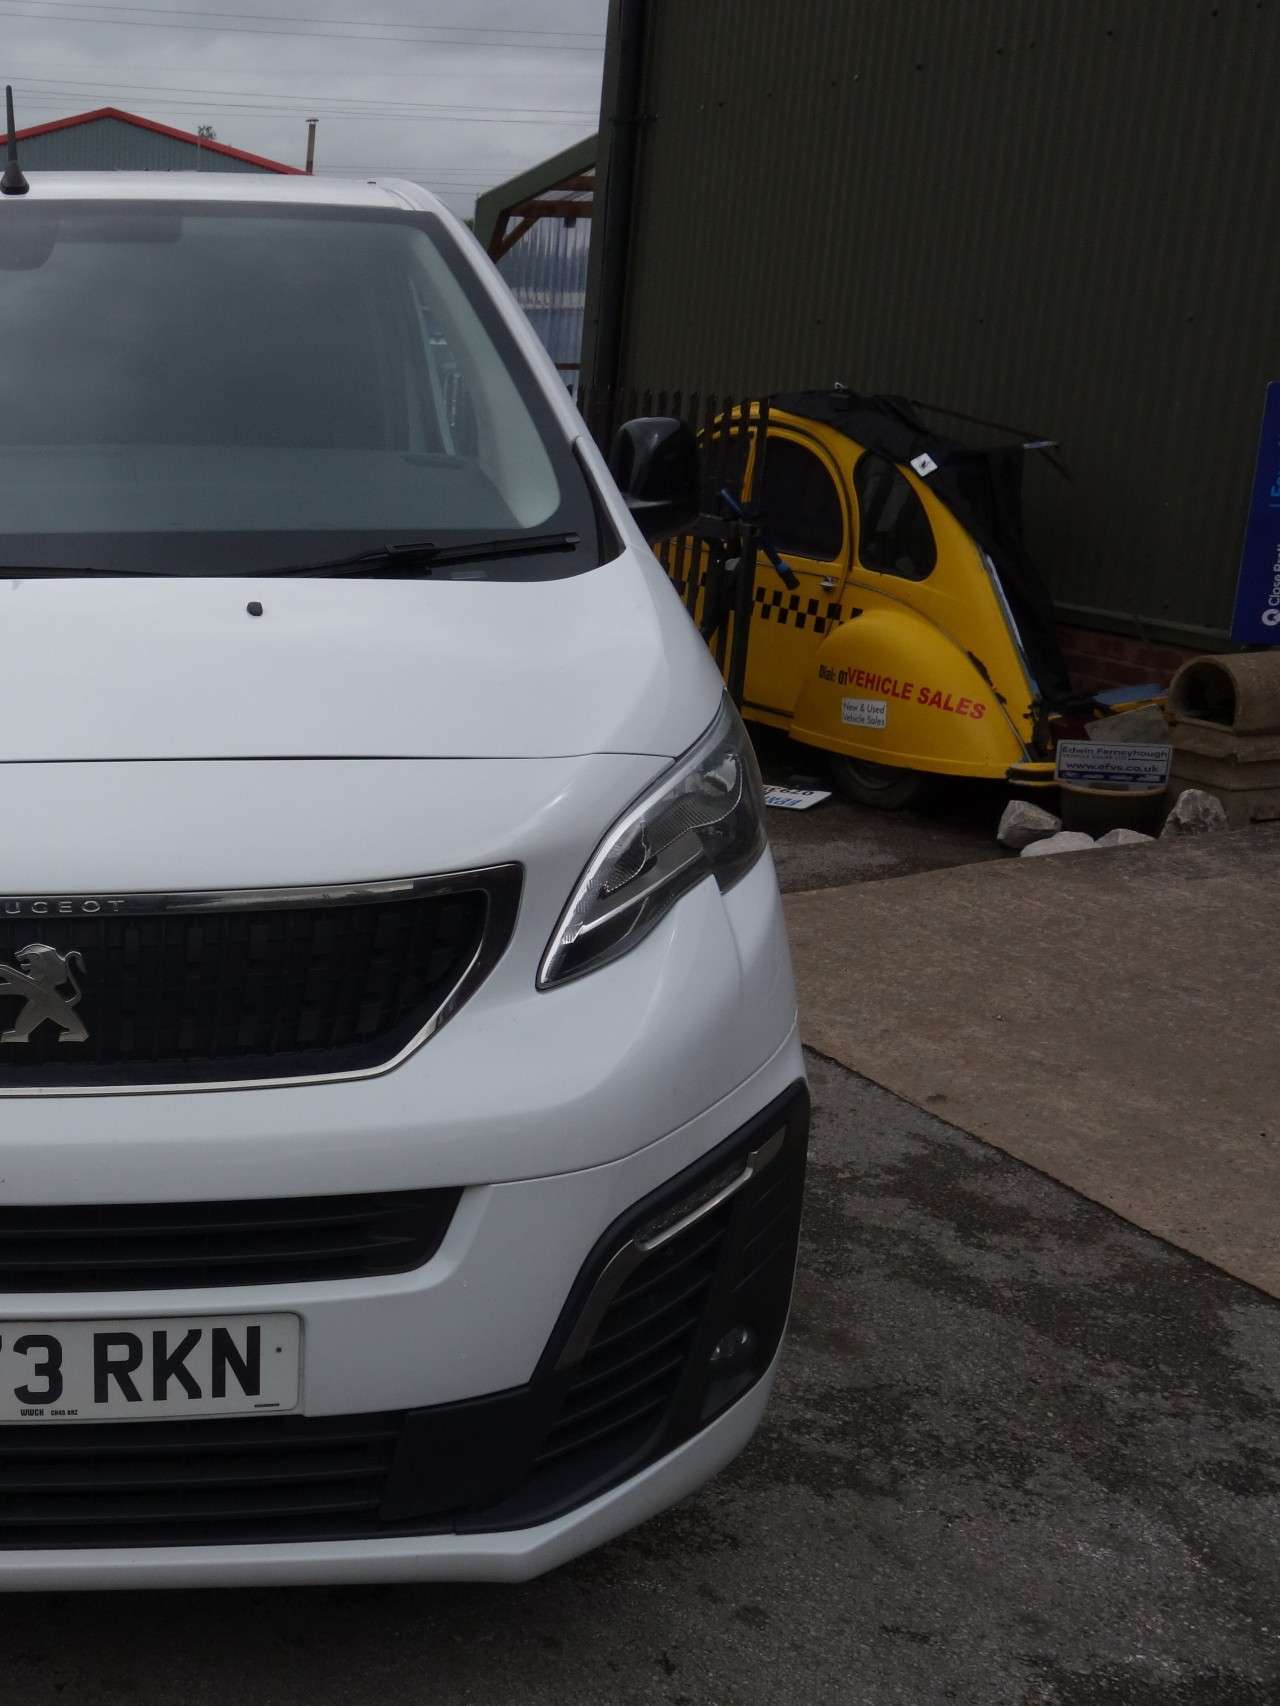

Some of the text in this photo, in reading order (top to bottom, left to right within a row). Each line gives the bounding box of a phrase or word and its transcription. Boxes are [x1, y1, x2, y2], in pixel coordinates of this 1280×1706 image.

[847, 667, 987, 719] VEHICLE SALES
[843, 703, 858, 712] New
[866, 703, 885, 715] Used
[843, 712, 885, 726] Vehicle Sales
[1062, 746, 1094, 755] Edwin
[93, 1326, 261, 1404] RKN
